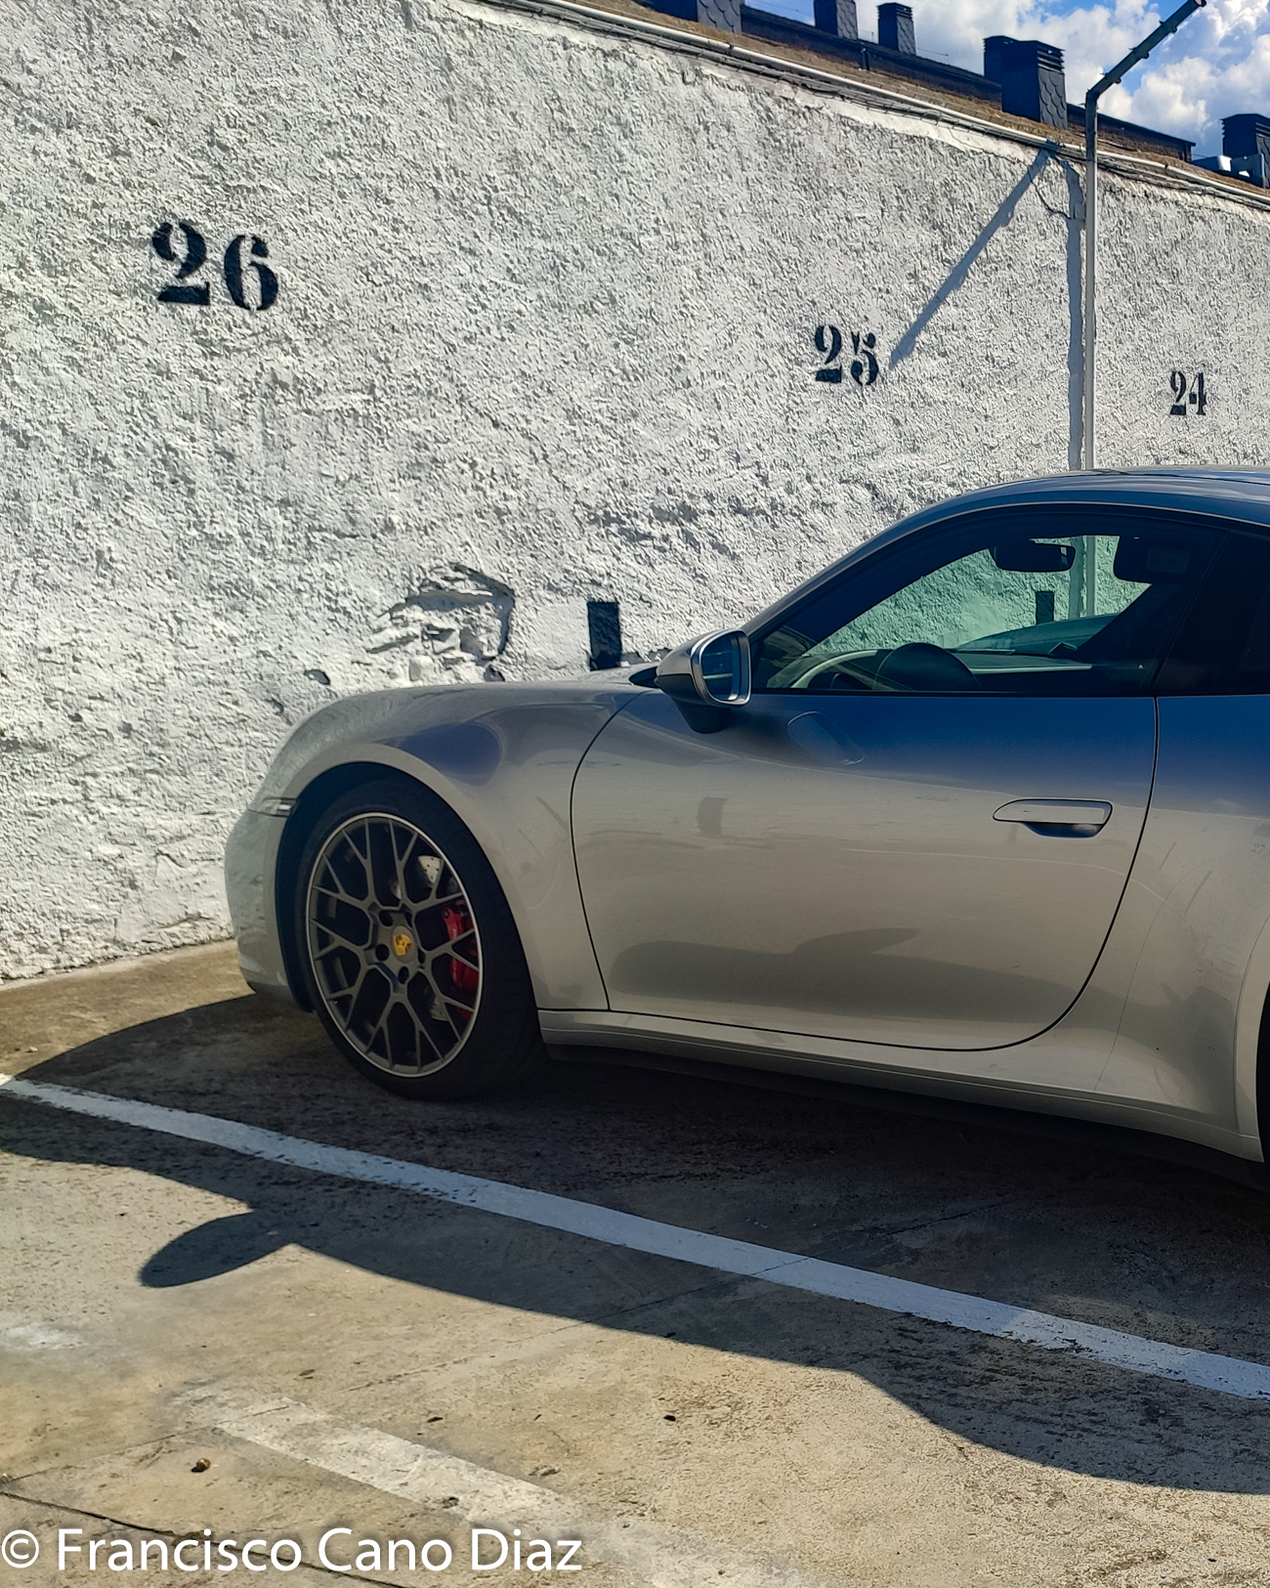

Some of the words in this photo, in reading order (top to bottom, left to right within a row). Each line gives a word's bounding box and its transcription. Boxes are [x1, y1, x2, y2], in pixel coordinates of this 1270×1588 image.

[151, 220, 279, 311] 26
[814, 324, 879, 387] 25
[1169, 370, 1208, 416] 24
